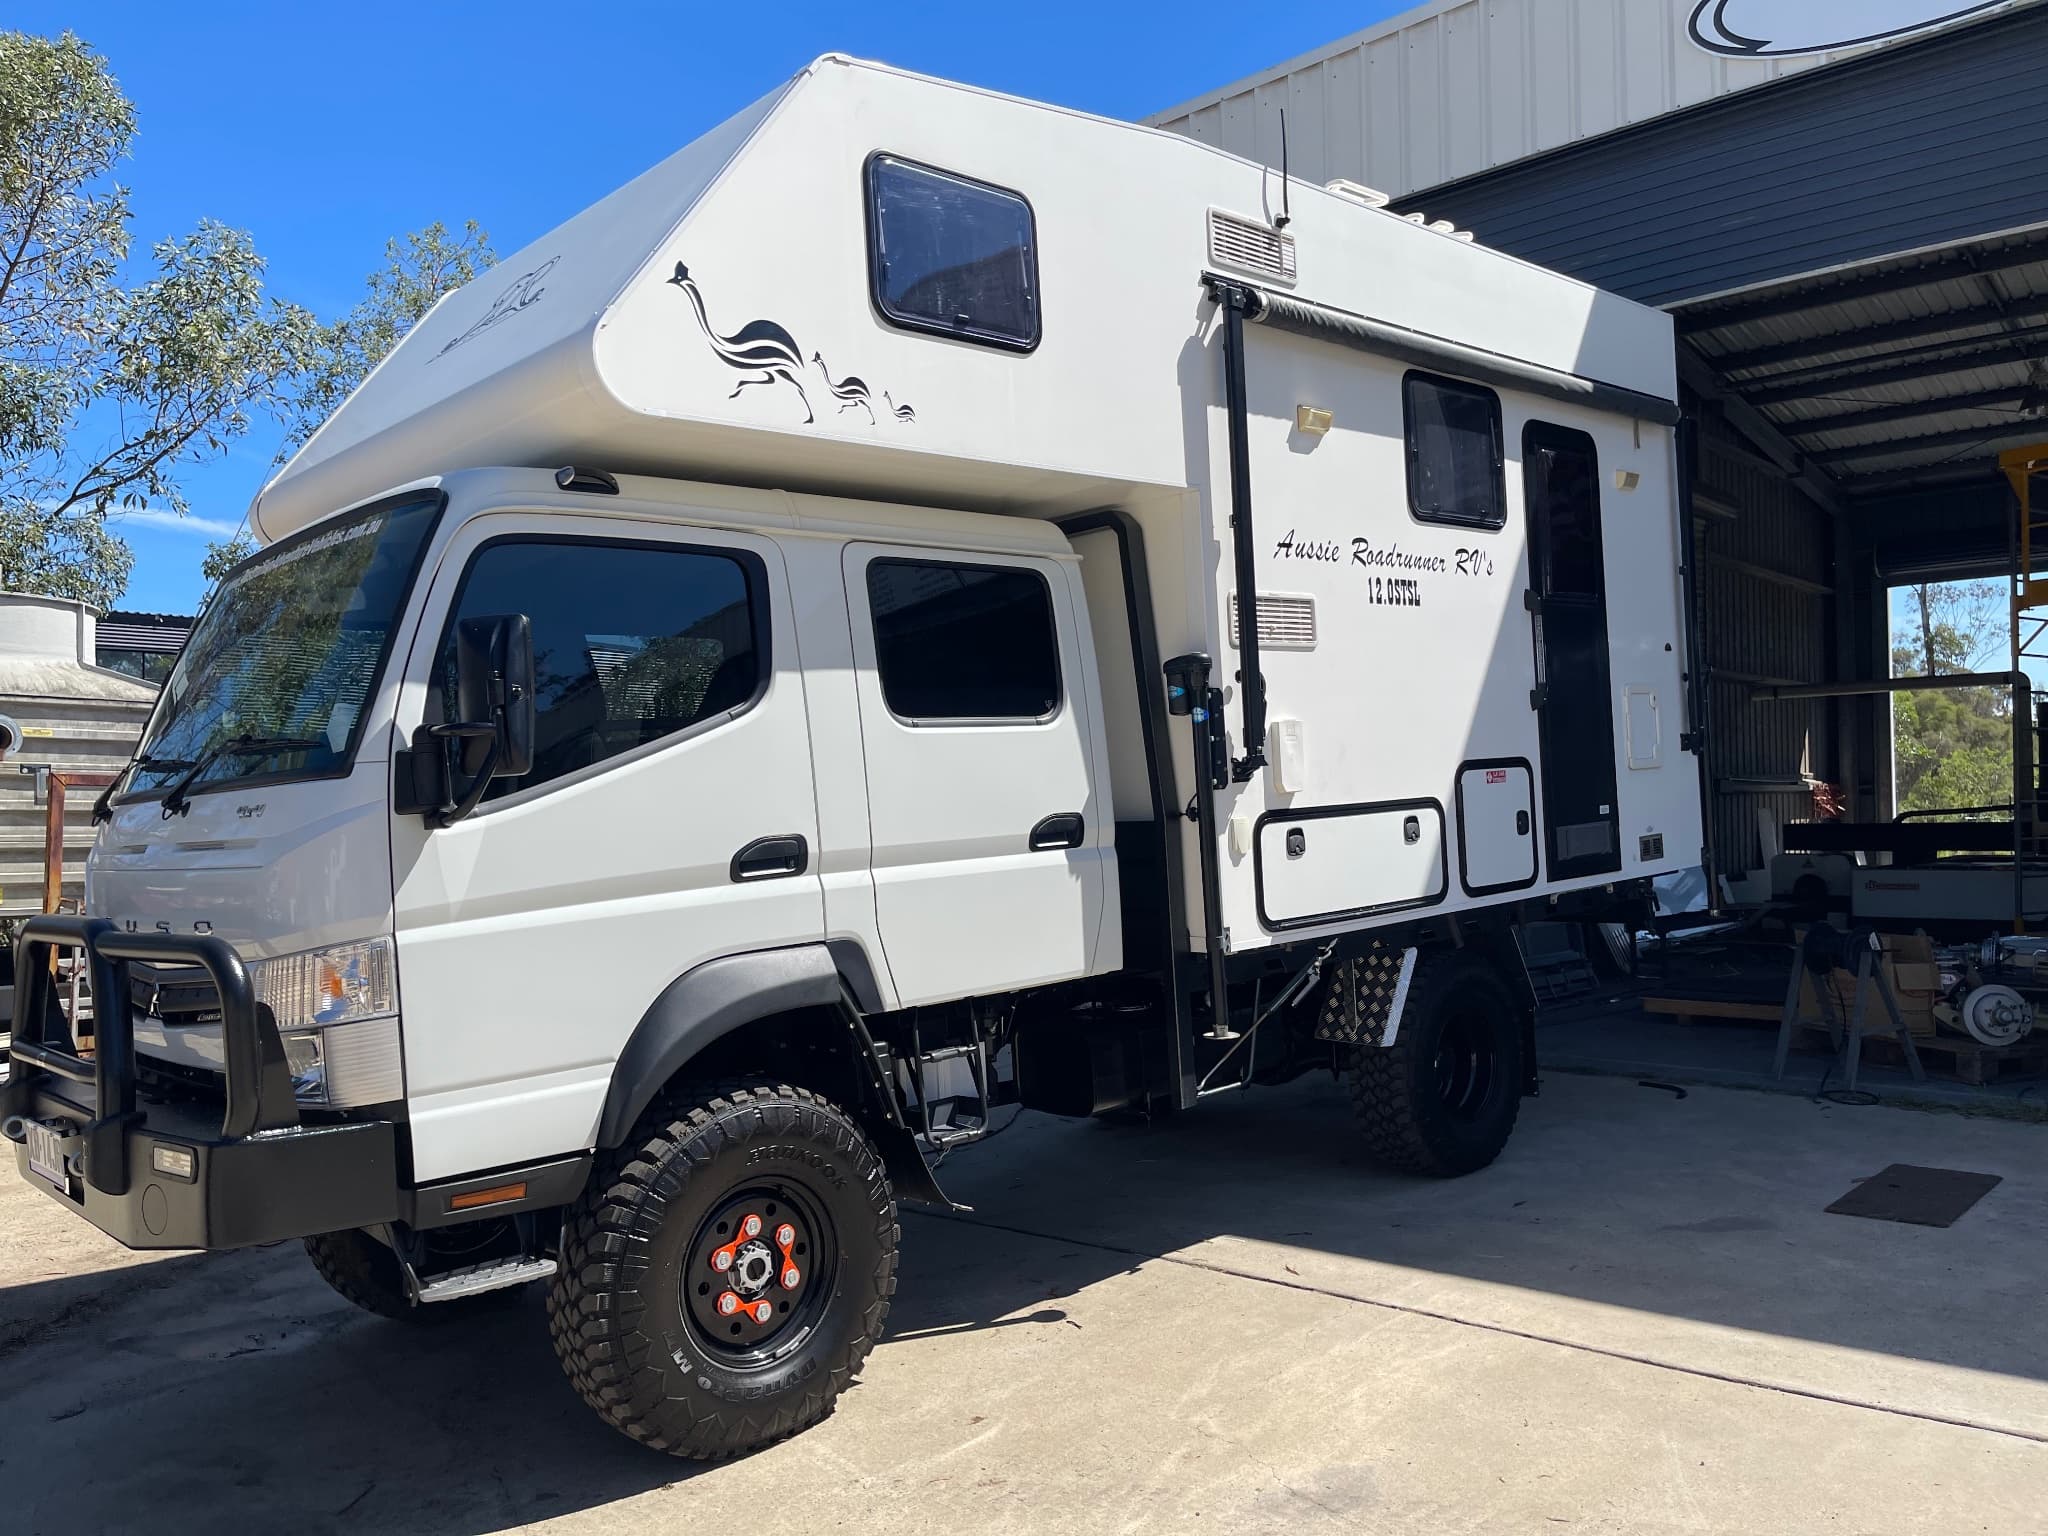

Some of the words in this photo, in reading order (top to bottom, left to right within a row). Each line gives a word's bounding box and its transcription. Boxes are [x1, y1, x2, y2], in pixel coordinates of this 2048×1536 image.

[1273, 528, 1341, 563] Aussie
[1351, 536, 1448, 573] Roadrunner
[1454, 548, 1494, 576] RV's
[106, 917, 214, 936] USO
